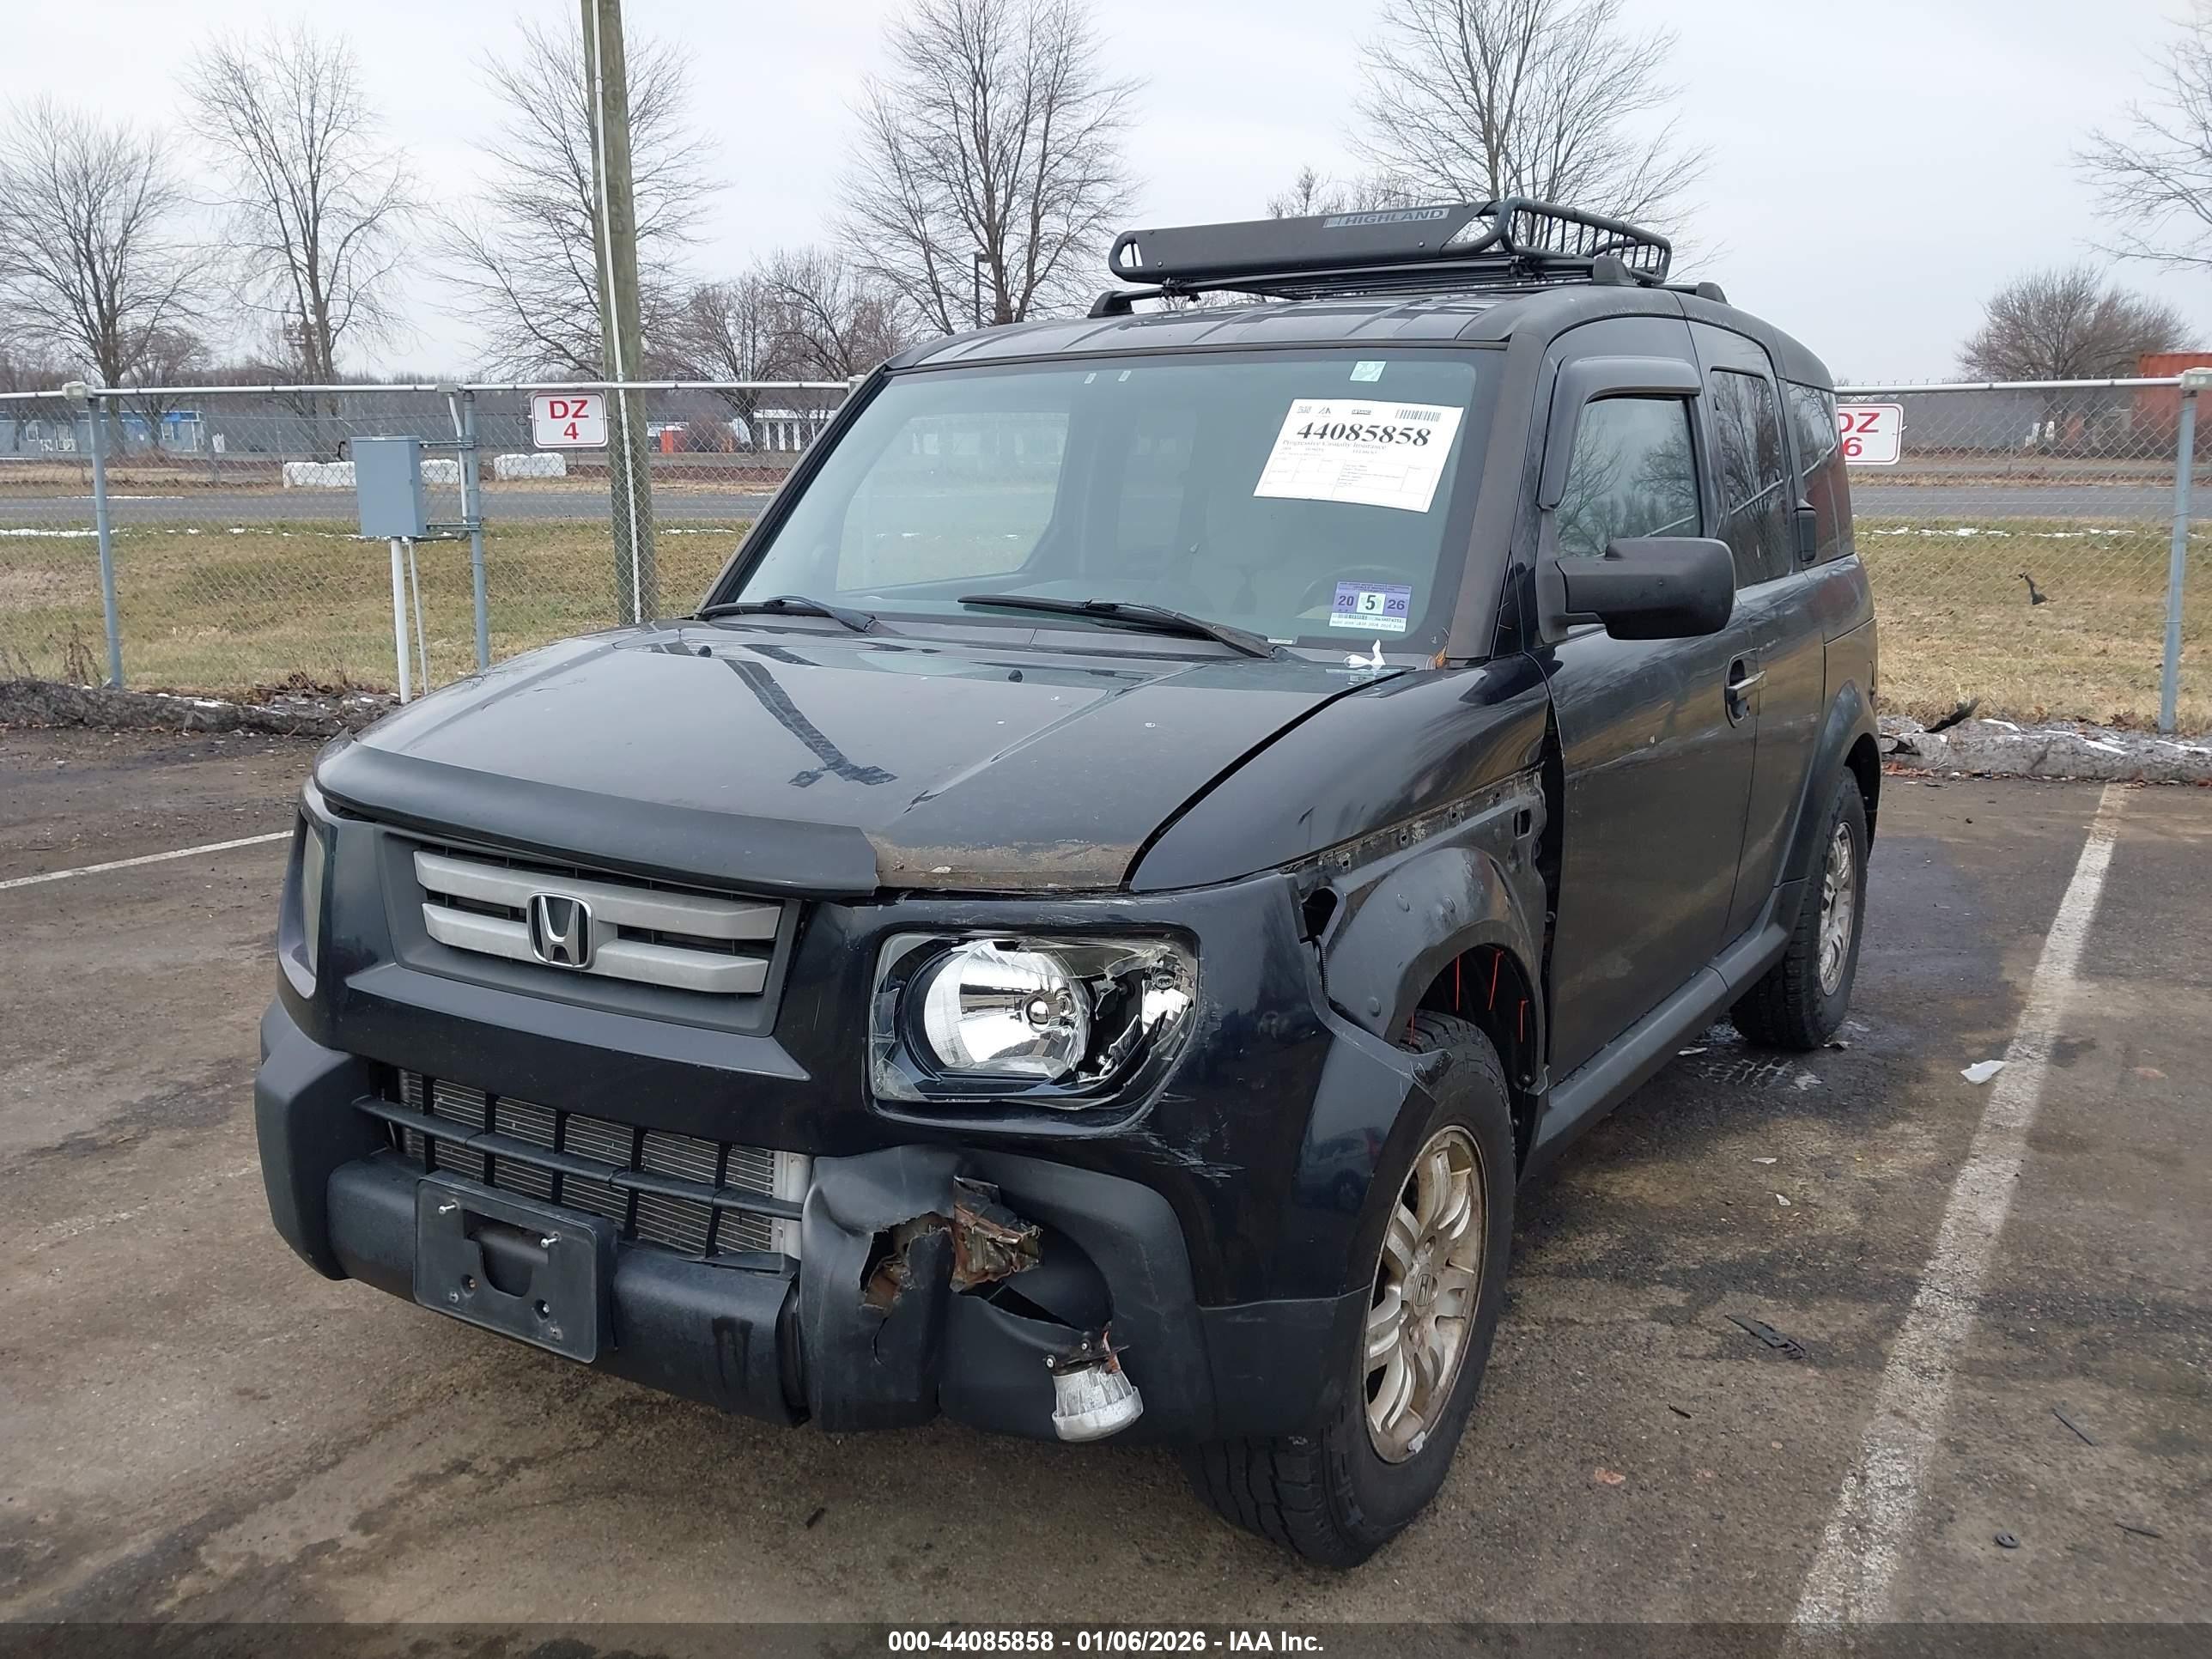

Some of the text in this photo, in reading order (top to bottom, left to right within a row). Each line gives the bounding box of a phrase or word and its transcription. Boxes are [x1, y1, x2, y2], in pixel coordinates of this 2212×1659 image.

[1345, 210, 1444, 225] HIGHLAND
[550, 399, 589, 419] DZ
[563, 422, 579, 440] 4
[1838, 412, 1880, 433] DZ
[1297, 422, 1431, 447] 44085858
[1843, 437, 1863, 456] 6
[1338, 595, 1406, 611] 20 5 26
